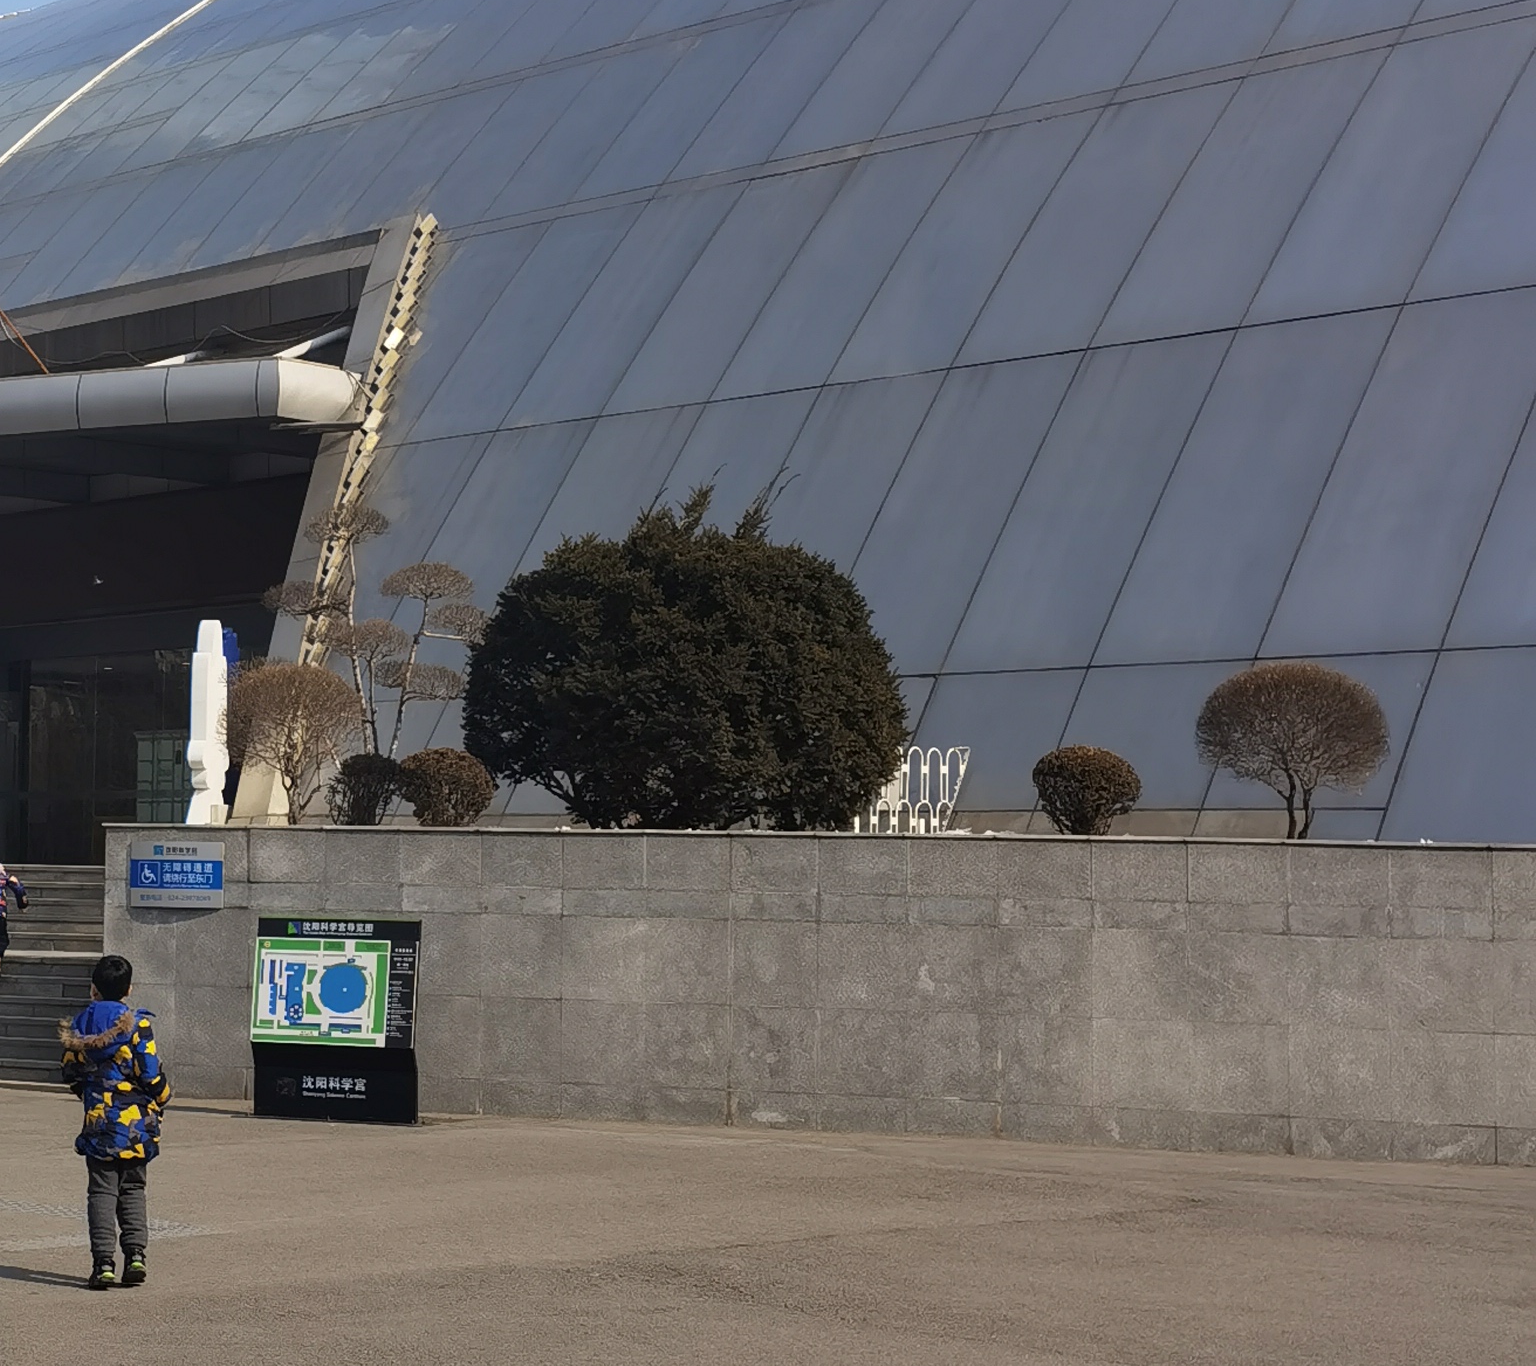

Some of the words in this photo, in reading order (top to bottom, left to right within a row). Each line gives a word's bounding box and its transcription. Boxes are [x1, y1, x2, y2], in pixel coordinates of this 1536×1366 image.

[162, 862, 213, 873] 无障碍通道
[162, 873, 213, 884] 请绕行至东门
[302, 1075, 367, 1092] 沈阳科学宫
